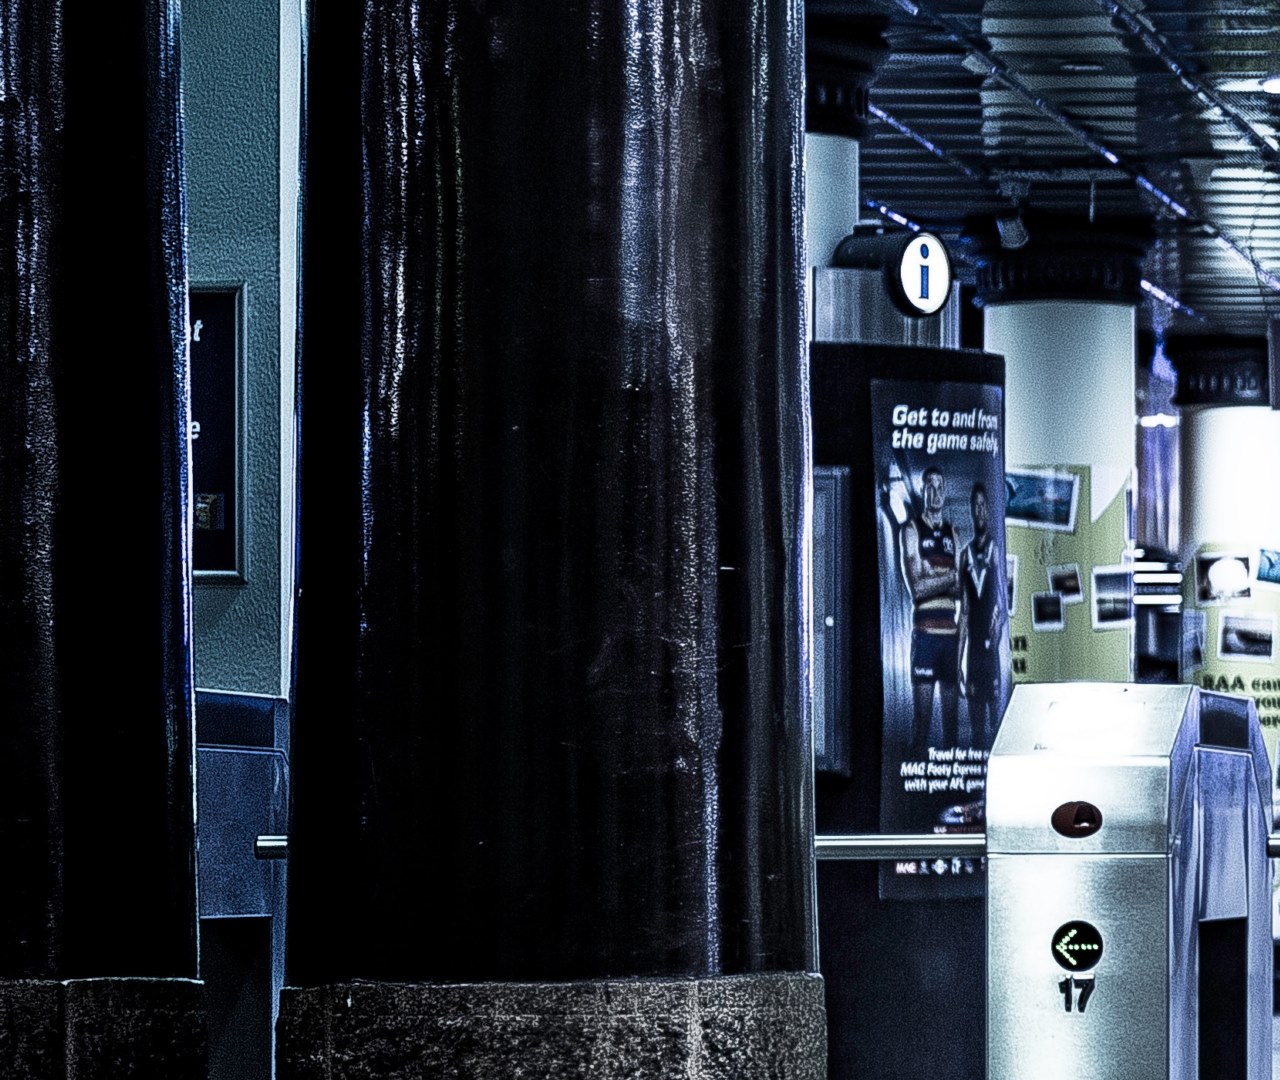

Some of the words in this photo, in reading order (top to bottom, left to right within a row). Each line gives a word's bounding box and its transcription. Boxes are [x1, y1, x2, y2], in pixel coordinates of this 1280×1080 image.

[919, 244, 929, 300] i
[892, 404, 928, 427] Get
[931, 408, 950, 427] to
[952, 408, 976, 429] and
[977, 409, 998, 430] from
[892, 427, 924, 449] the
[926, 432, 968, 454] game
[928, 746, 954, 761] Travel
[955, 746, 967, 760] for
[968, 746, 983, 761] free
[904, 778, 927, 791] with
[928, 779, 948, 794] your
[1058, 974, 1096, 1013] 17
